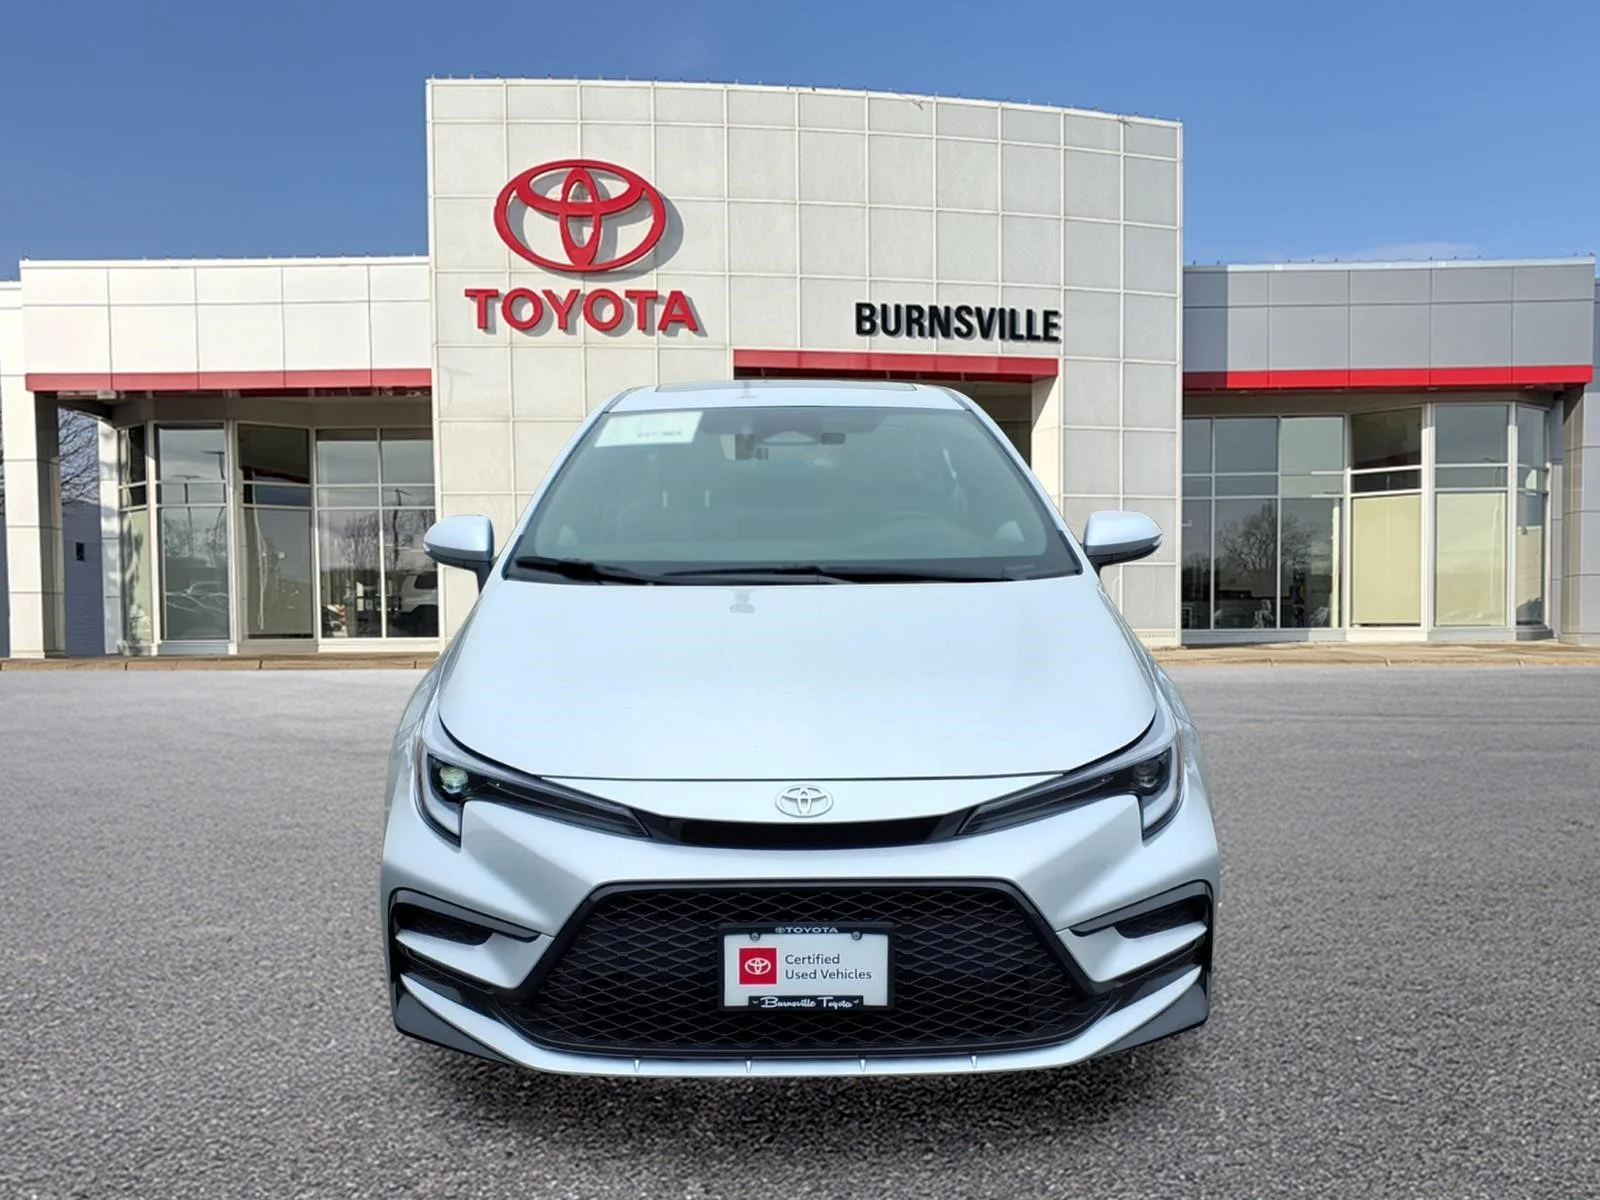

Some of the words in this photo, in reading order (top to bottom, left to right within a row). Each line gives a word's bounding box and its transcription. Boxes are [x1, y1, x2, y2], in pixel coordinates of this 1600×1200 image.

[464, 287, 698, 332] TOYOTA
[855, 302, 1061, 342] BURNSVILLE
[785, 926, 839, 934] TOYOTA
[784, 953, 841, 965] Certified
[784, 968, 817, 980] Used
[820, 968, 872, 980] Vehicles
[760, 996, 817, 1008] Burnsville
[817, 996, 854, 1010] Toyota
